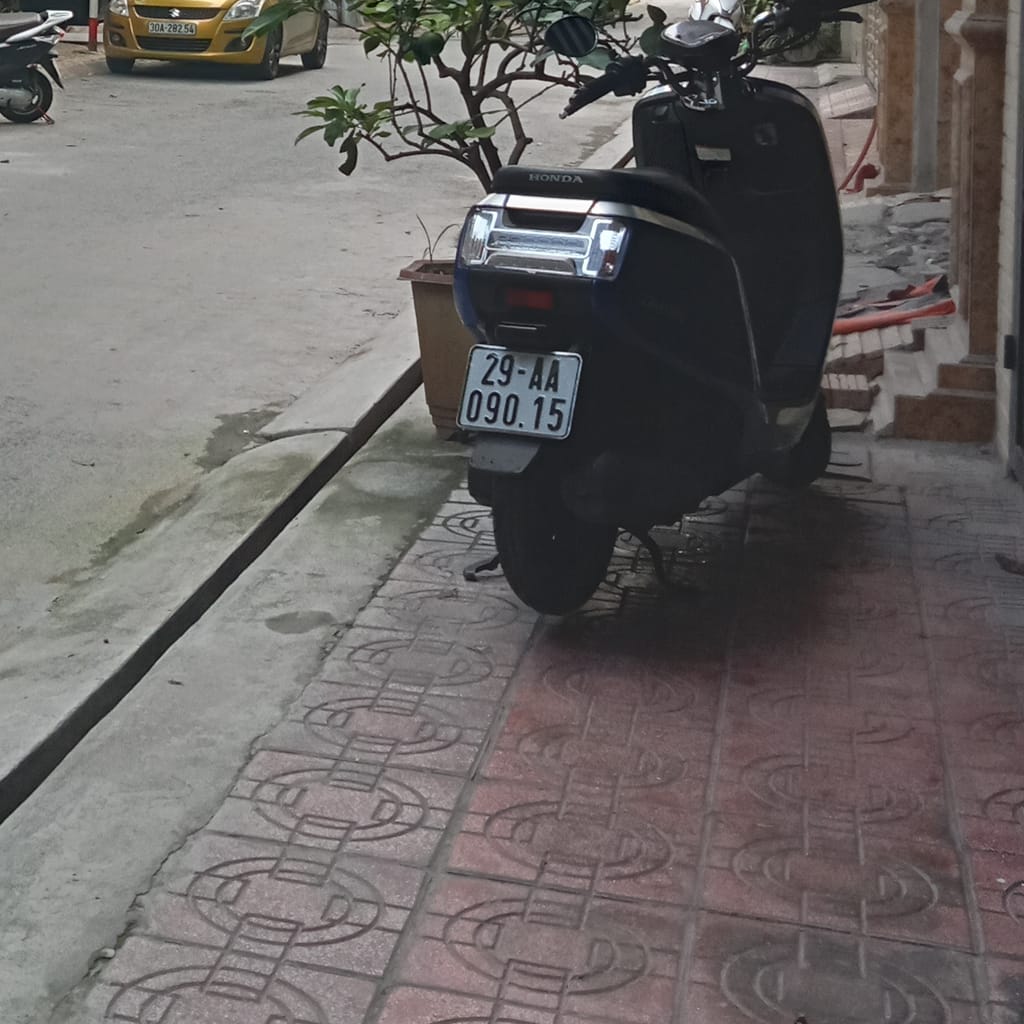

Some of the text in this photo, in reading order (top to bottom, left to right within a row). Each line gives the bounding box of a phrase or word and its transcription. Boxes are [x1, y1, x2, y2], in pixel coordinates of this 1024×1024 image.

[528, 173, 583, 183] HONDA
[481, 353, 560, 392] 29-AA
[466, 390, 566, 431] 090.15
